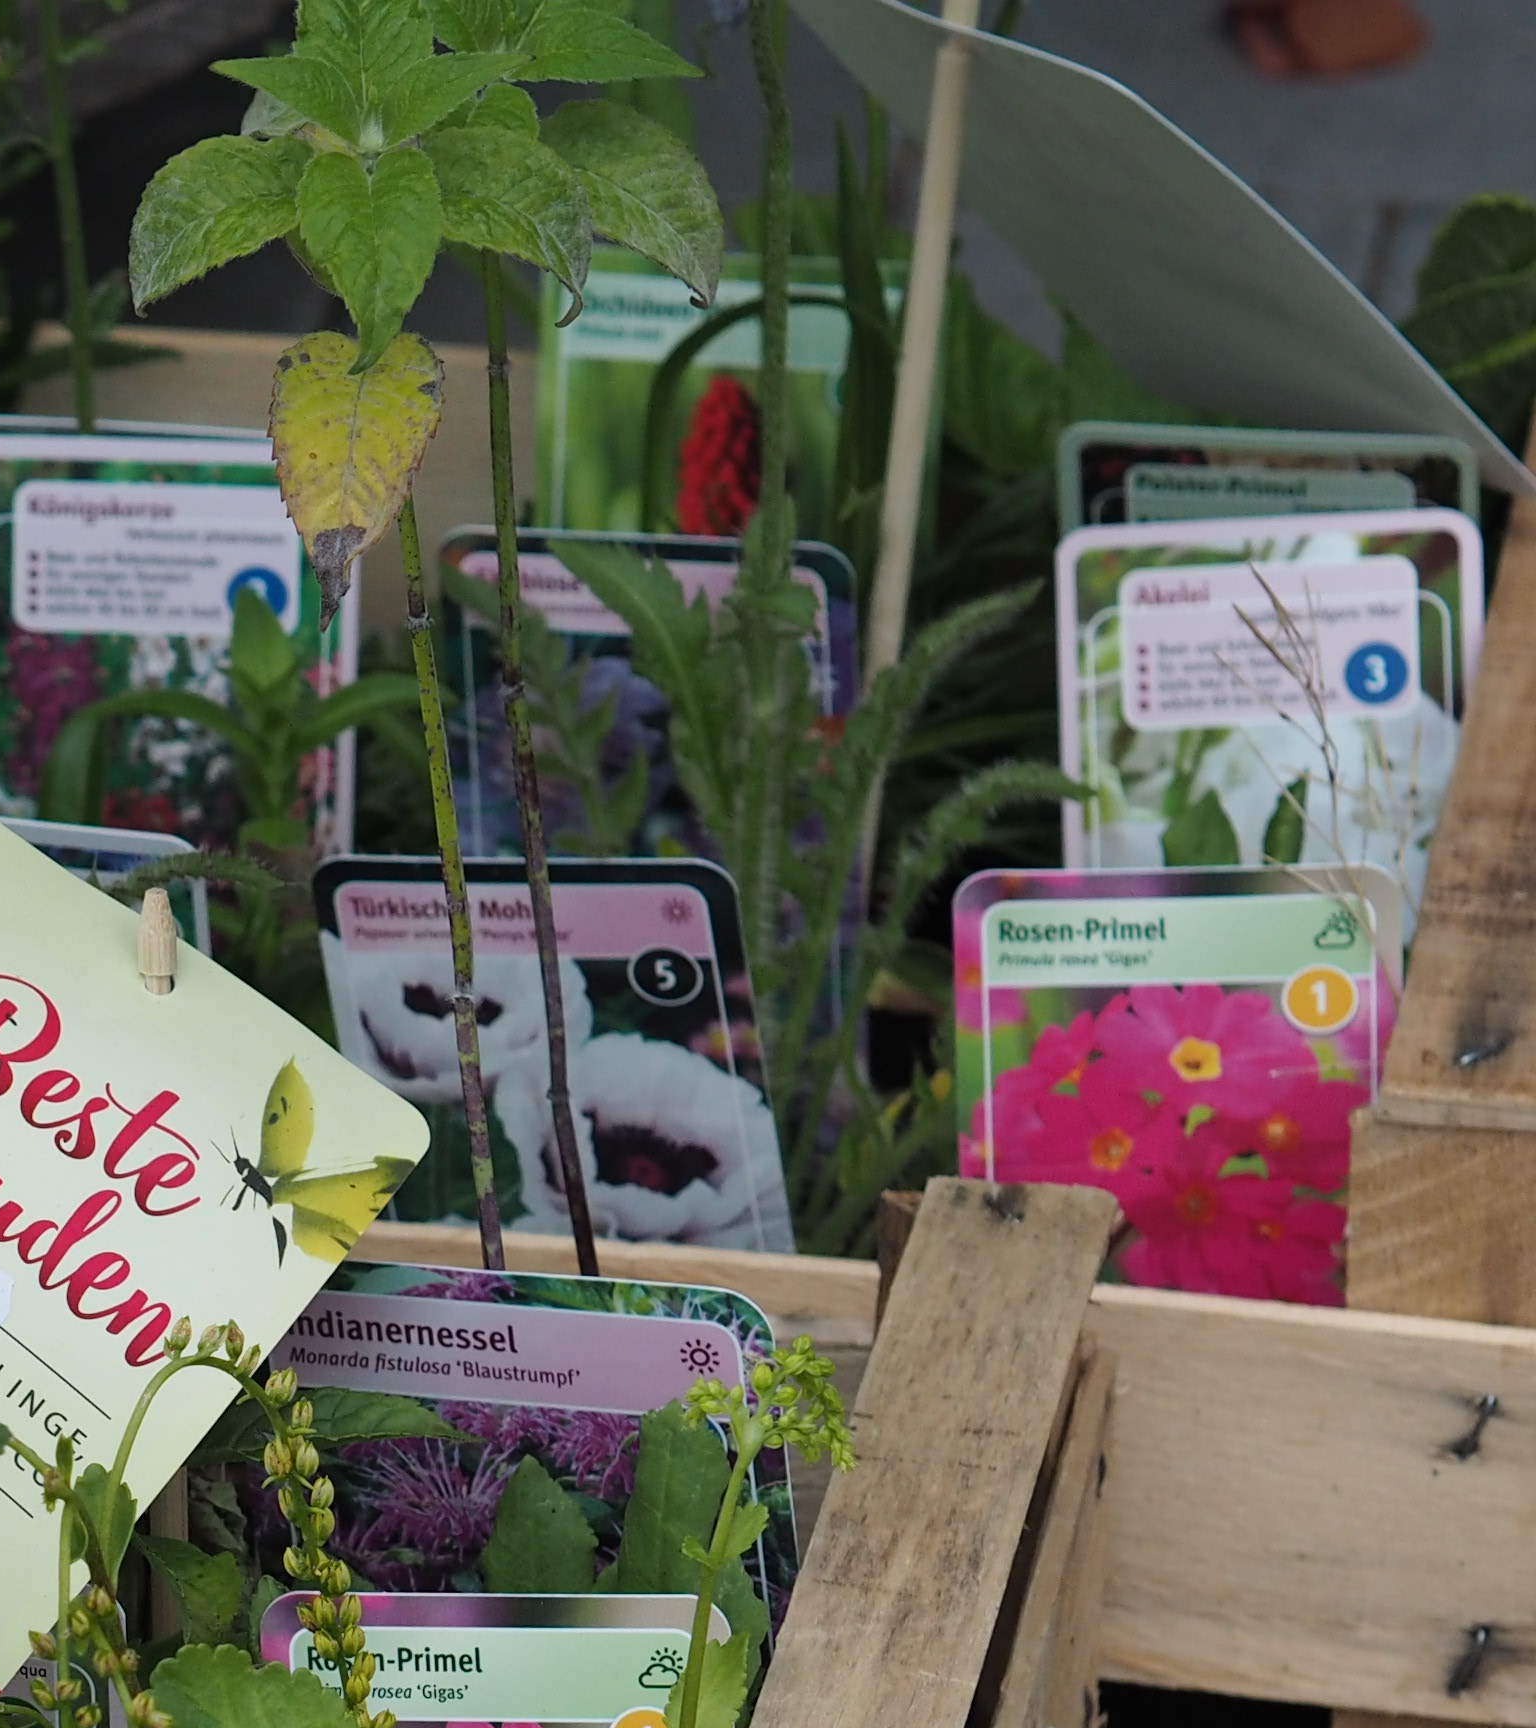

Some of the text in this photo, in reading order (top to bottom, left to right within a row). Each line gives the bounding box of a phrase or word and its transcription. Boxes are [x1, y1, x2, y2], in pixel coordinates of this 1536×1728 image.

[1132, 580, 1212, 604] Akelei
[1363, 653, 1388, 694] 3
[349, 896, 533, 920] Türkisch Moh
[997, 917, 1167, 945] Rosen-Primel
[653, 958, 677, 991] 5
[1308, 979, 1328, 1016] 1
[288, 1311, 519, 1354] ndianernessel
[289, 1347, 370, 1369] Monarda
[375, 1352, 452, 1375] fistulosa
[371, 1686, 413, 1700] rosea
